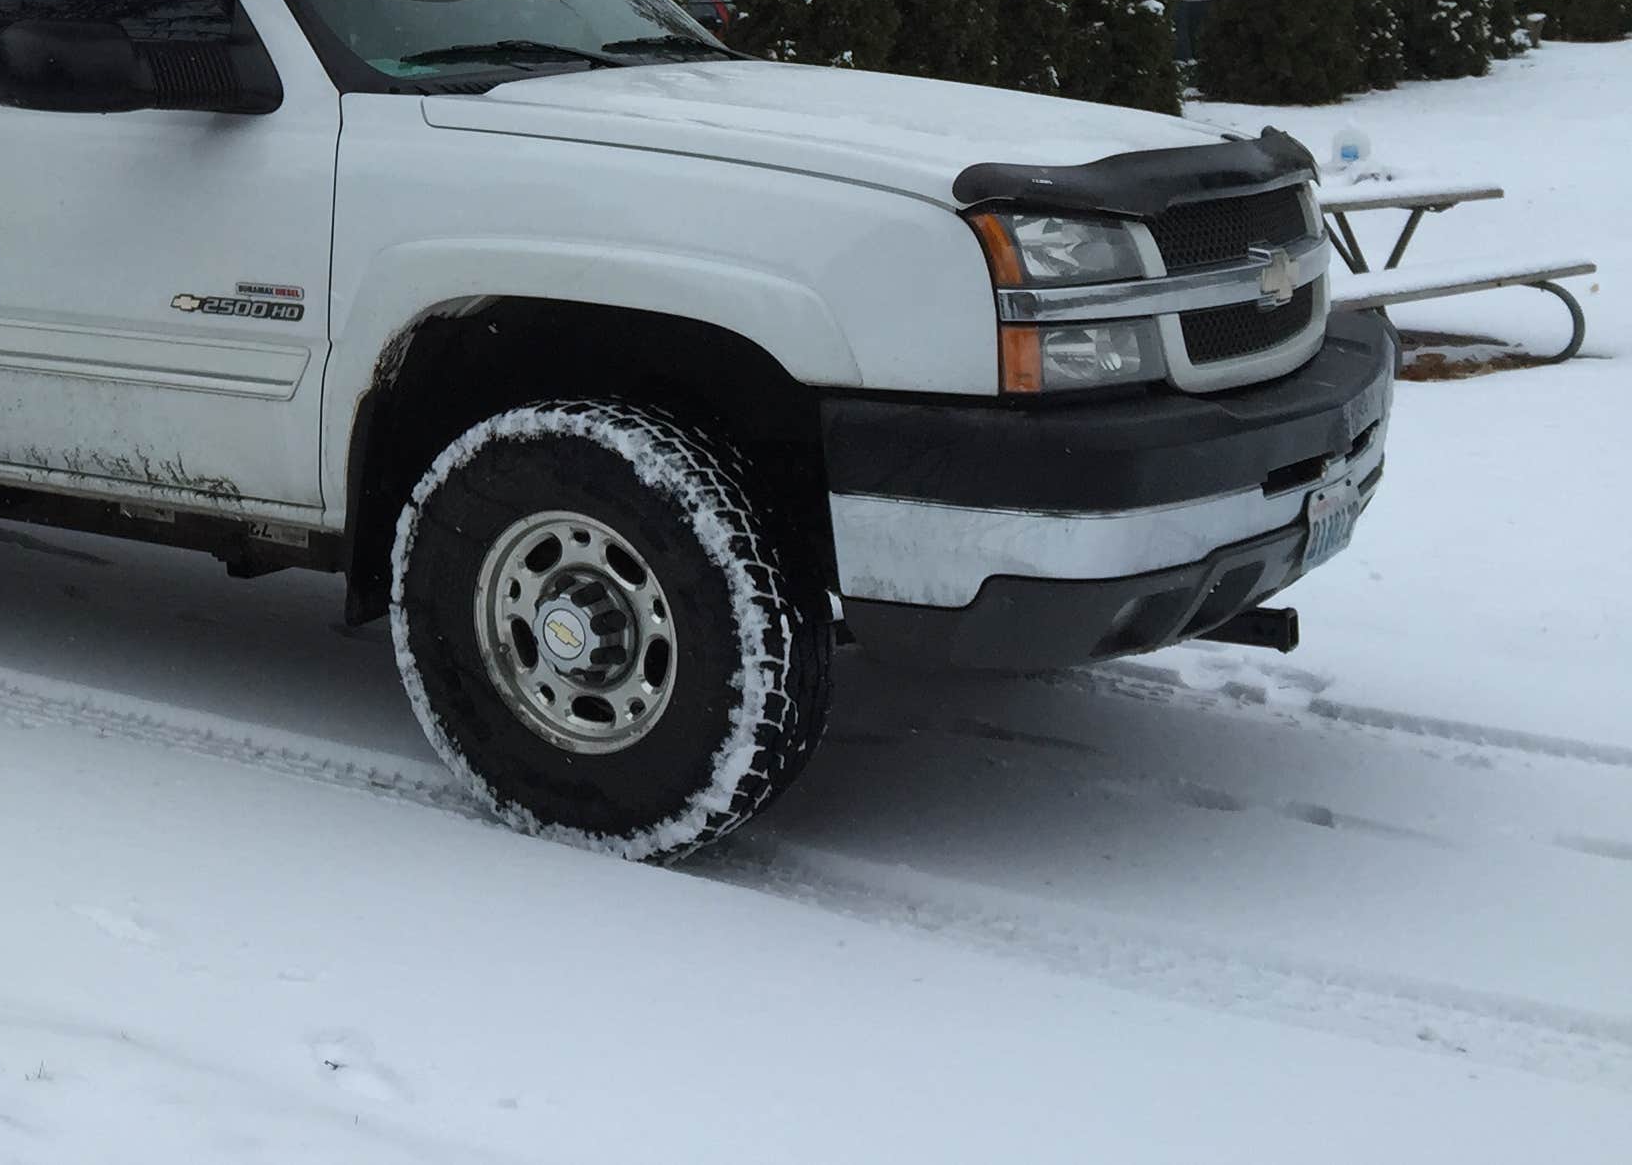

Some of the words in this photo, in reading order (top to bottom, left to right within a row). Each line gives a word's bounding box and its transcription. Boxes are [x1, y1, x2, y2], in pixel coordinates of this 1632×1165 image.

[238, 284, 274, 295] DURAMAX
[274, 288, 301, 298] DIESEL
[202, 297, 268, 317] 2500
[271, 305, 300, 319] HD
